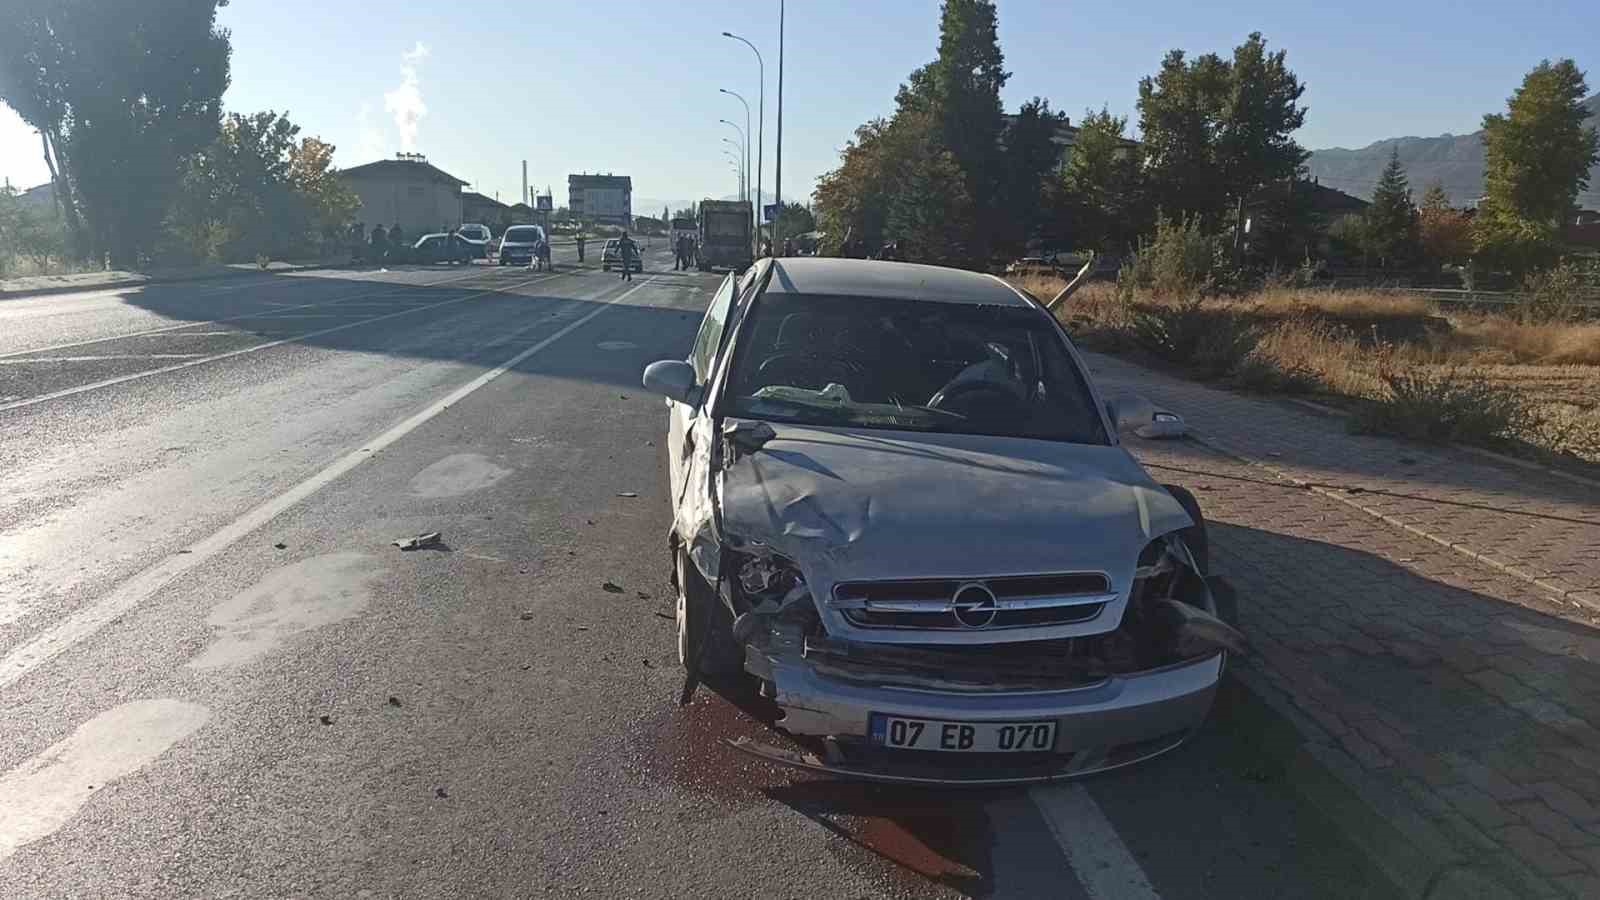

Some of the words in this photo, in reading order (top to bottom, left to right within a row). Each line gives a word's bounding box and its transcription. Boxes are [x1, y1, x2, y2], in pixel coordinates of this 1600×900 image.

[890, 720, 925, 748] 07
[941, 724, 976, 751] EB
[998, 725, 1050, 750] 070
